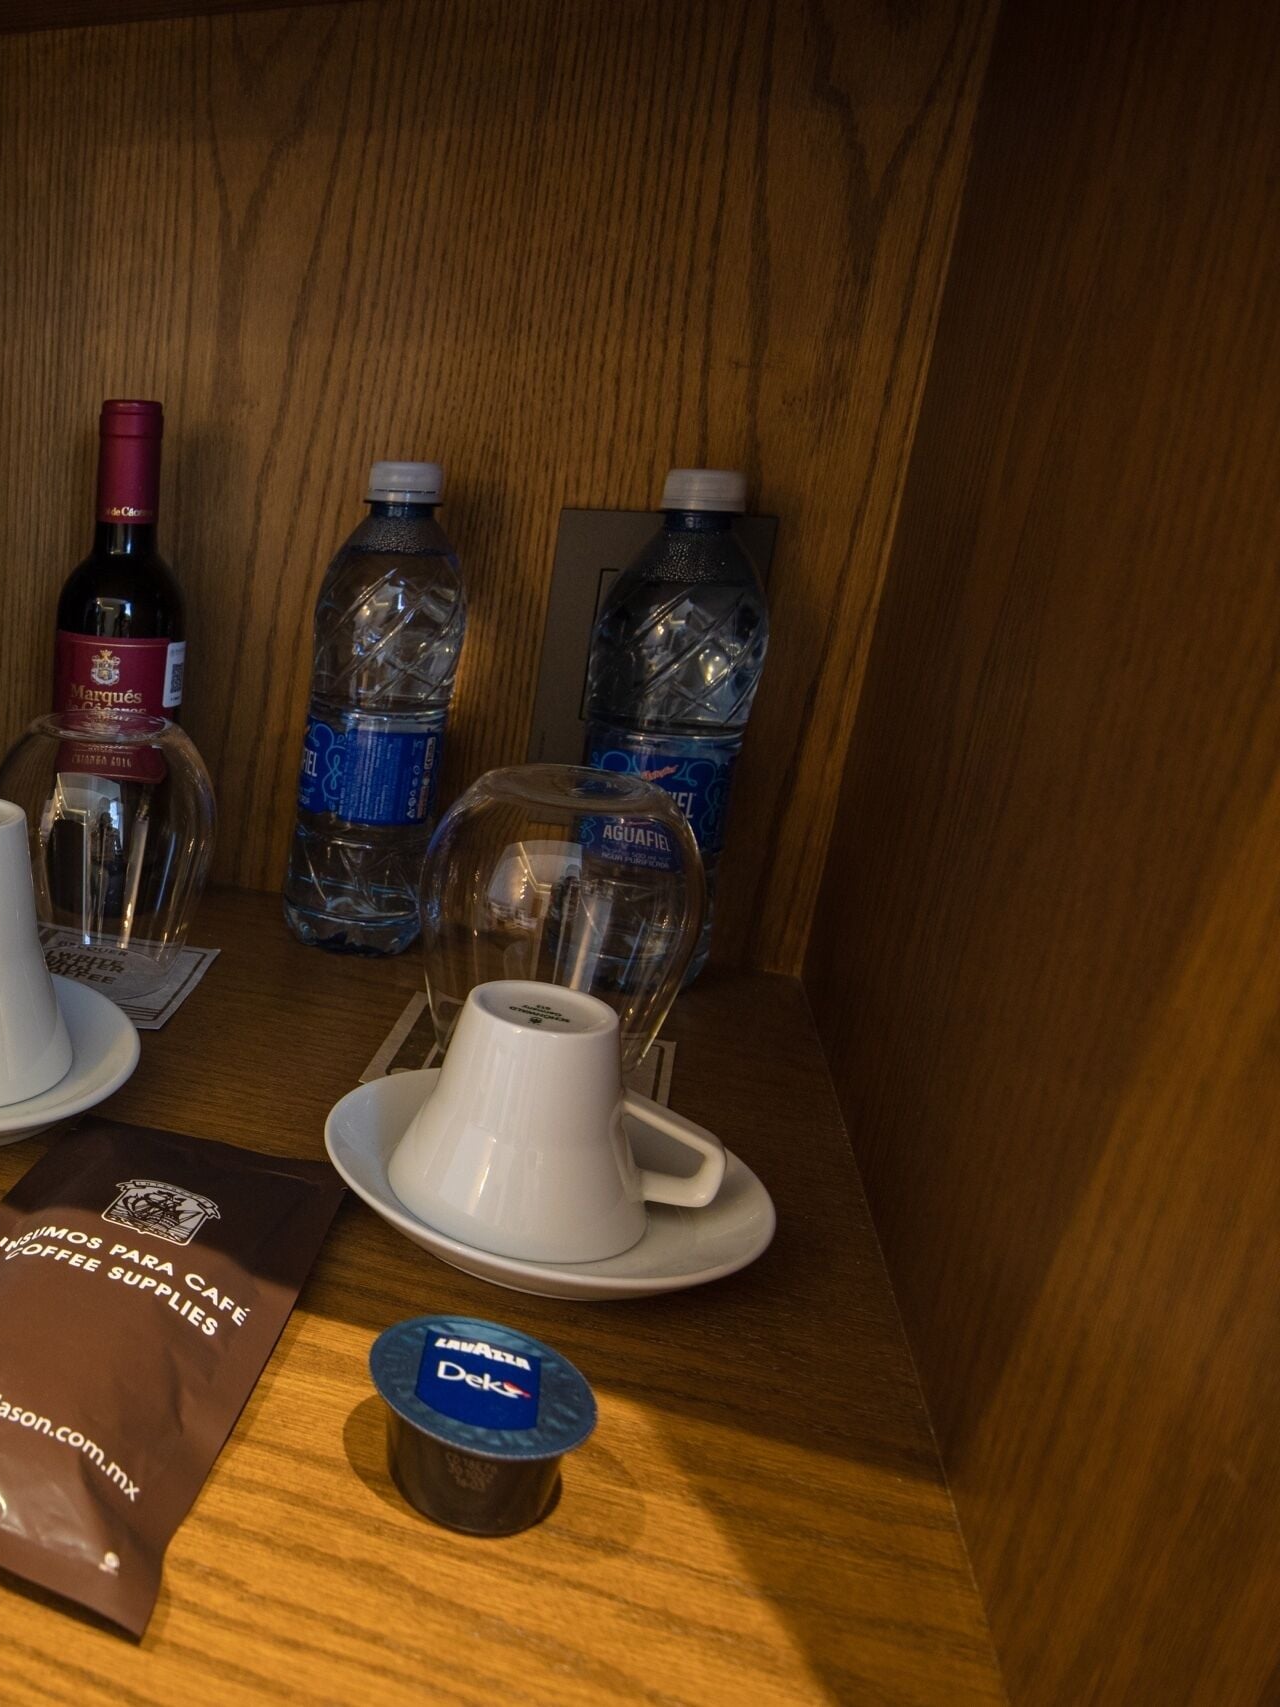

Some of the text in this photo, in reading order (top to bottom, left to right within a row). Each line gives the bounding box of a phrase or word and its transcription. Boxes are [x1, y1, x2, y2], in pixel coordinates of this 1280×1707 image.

[70, 684, 143, 707] Marqués
[602, 824, 673, 852] AGUAFIEL
[48, 967, 117, 985] OFFEE
[4, 1243, 219, 1337] COFFEE SUPPLIES
[109, 1243, 174, 1277] PARA
[184, 1273, 252, 1327] CAFÉ
[434, 1337, 532, 1372] LAVAZZA
